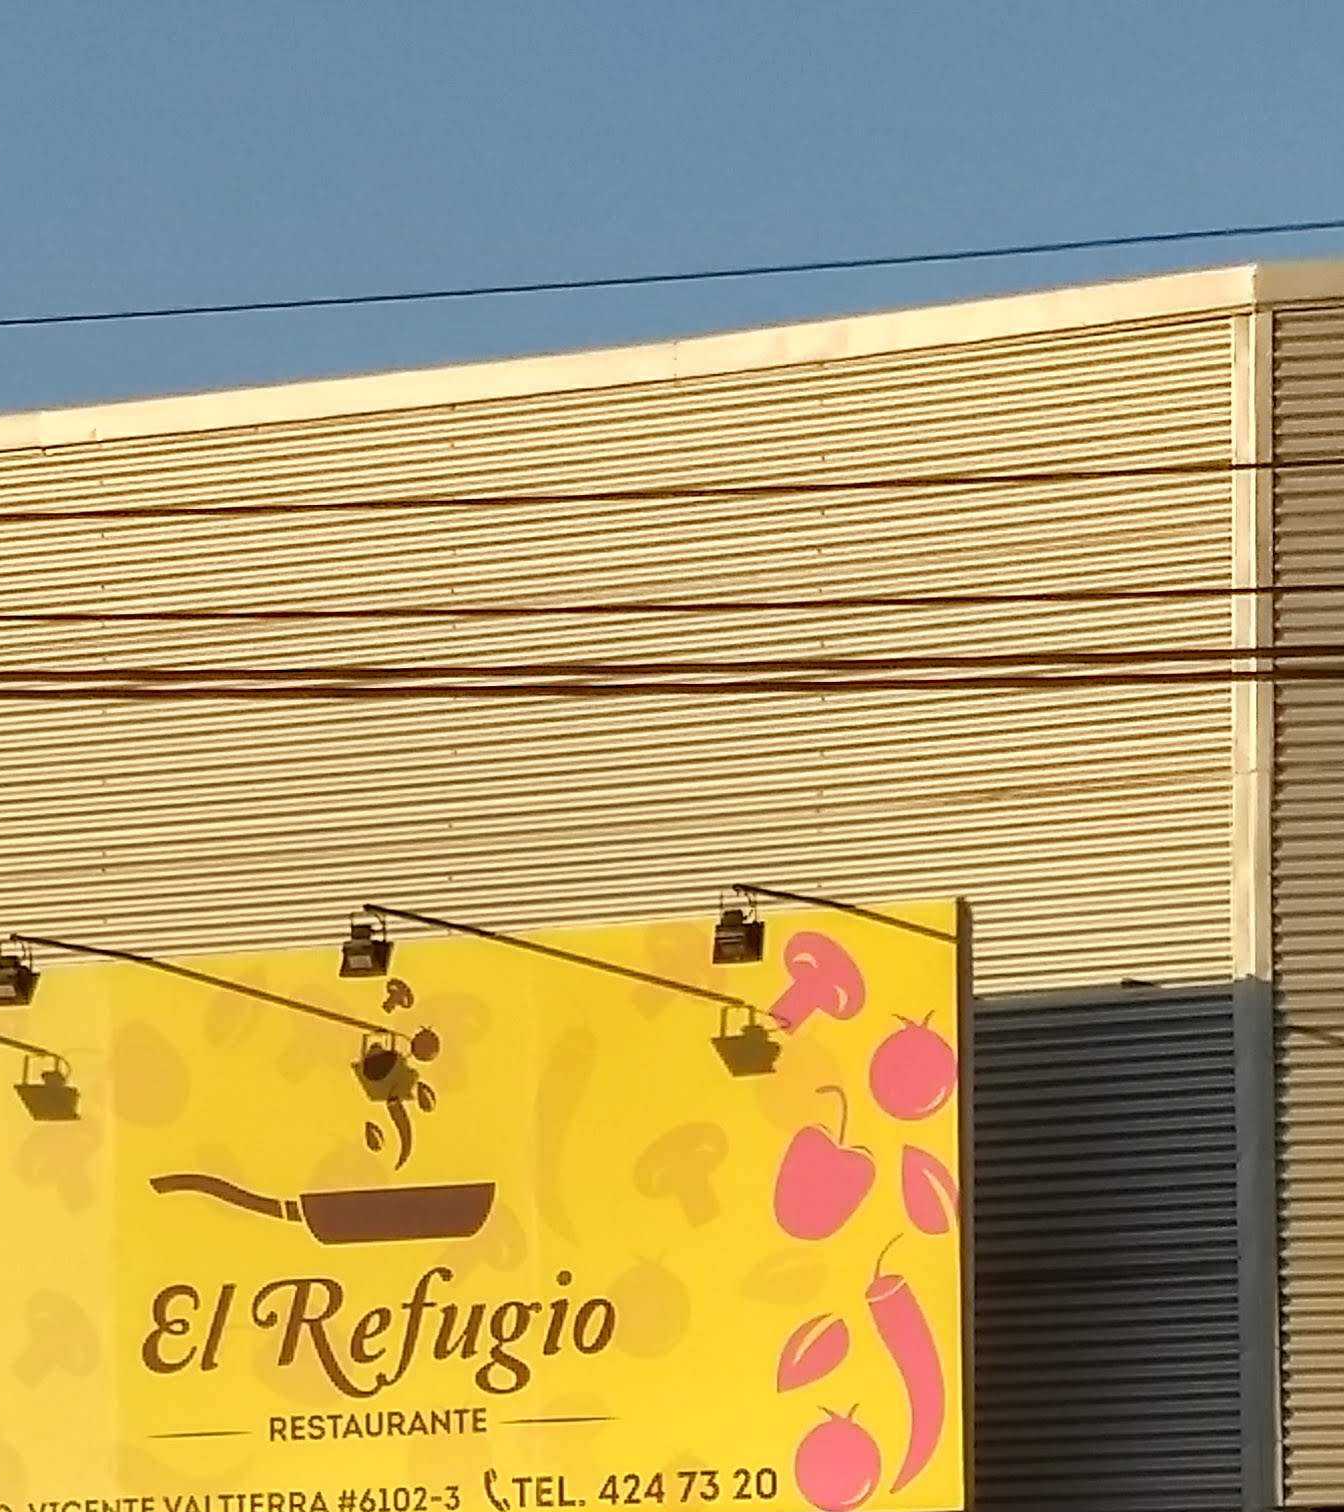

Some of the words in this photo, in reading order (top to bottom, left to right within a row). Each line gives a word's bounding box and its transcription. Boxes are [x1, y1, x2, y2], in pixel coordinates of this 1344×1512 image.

[141, 1282, 236, 1377] El
[251, 1267, 616, 1398] Refugio
[269, 1409, 488, 1442] RESTAURANTE
[511, 1476, 586, 1509] TEL.
[597, 1473, 666, 1507] 424
[676, 1470, 726, 1505] 73
[732, 1466, 778, 1502] 20
